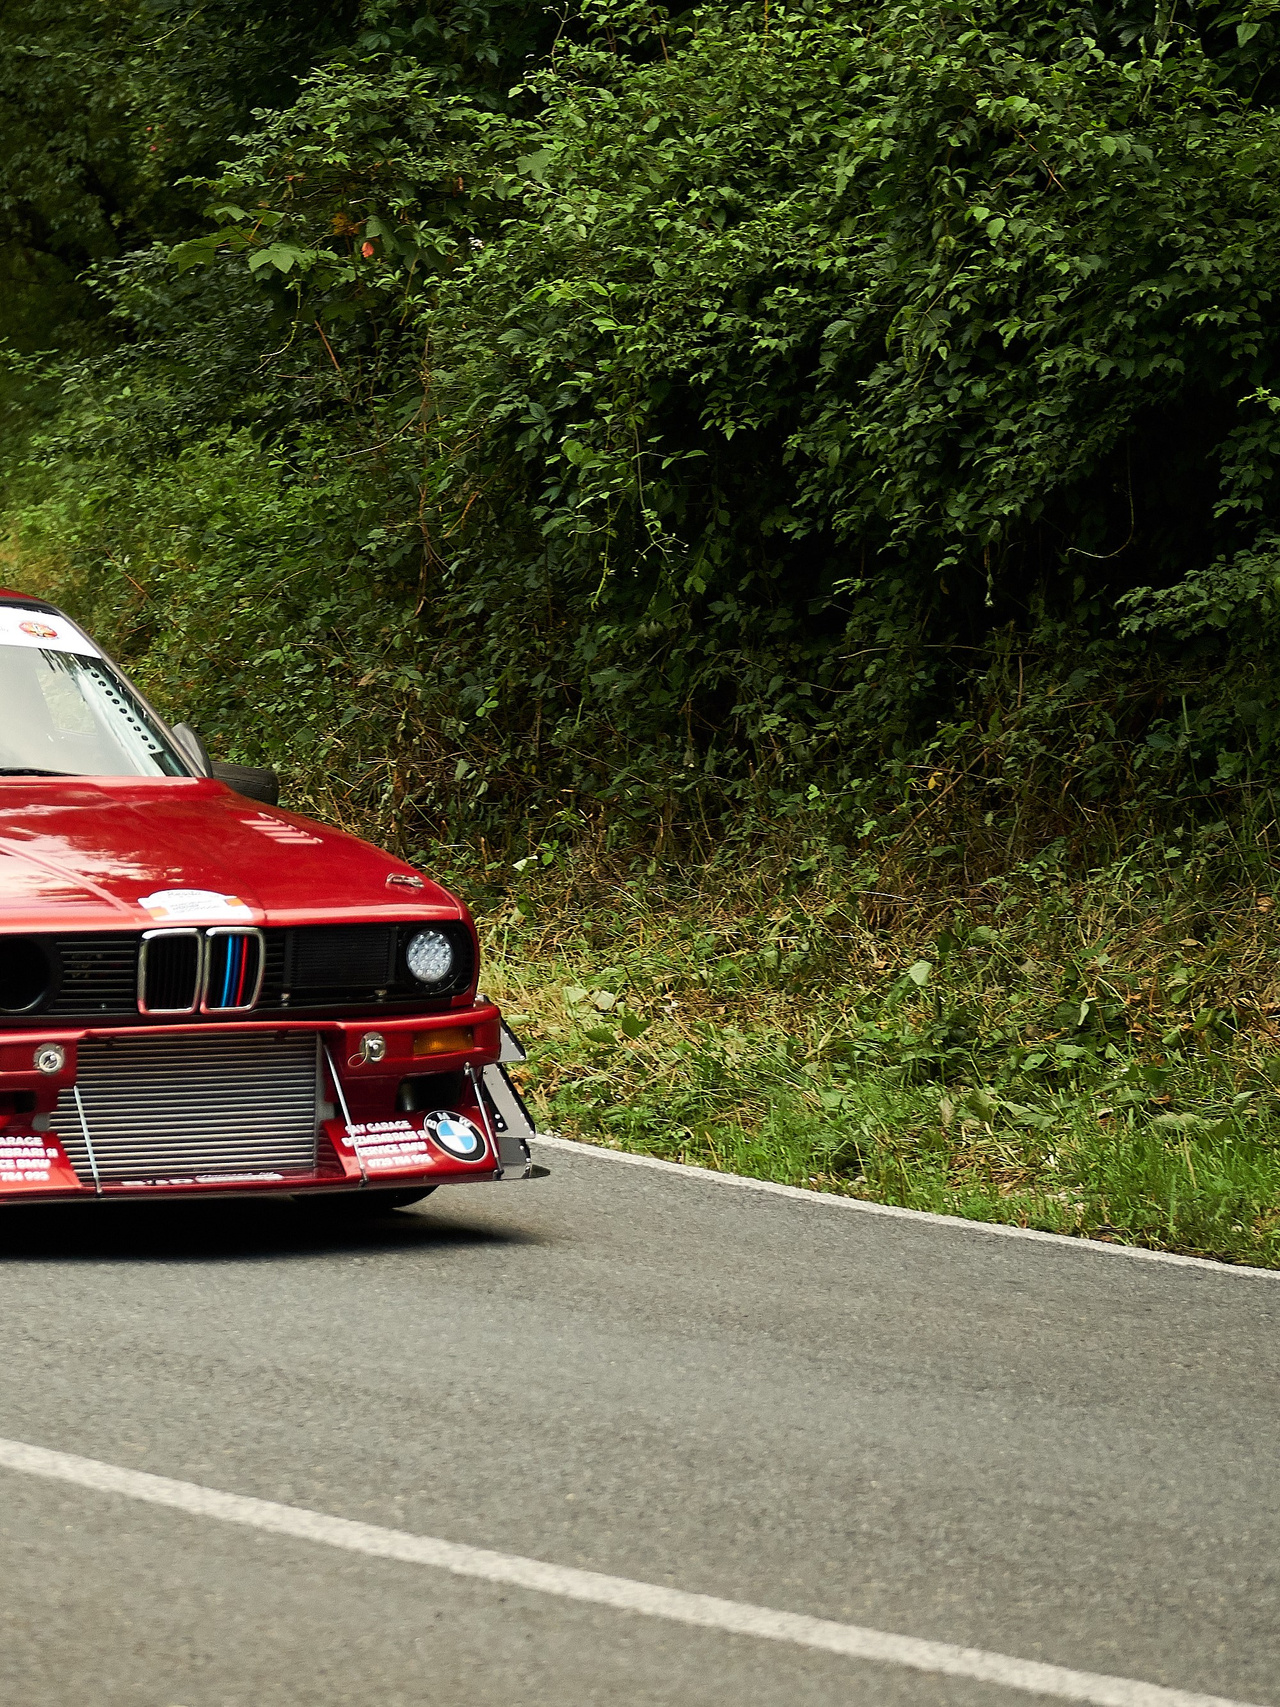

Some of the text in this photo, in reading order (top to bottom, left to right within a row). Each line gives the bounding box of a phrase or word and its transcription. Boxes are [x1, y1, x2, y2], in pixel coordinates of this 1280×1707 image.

[366, 1120, 412, 1133] GARAGE
[426, 1112, 473, 1130] BMW
[357, 1142, 427, 1157] SERVICE BMW
[16, 1159, 51, 1169] BMW
